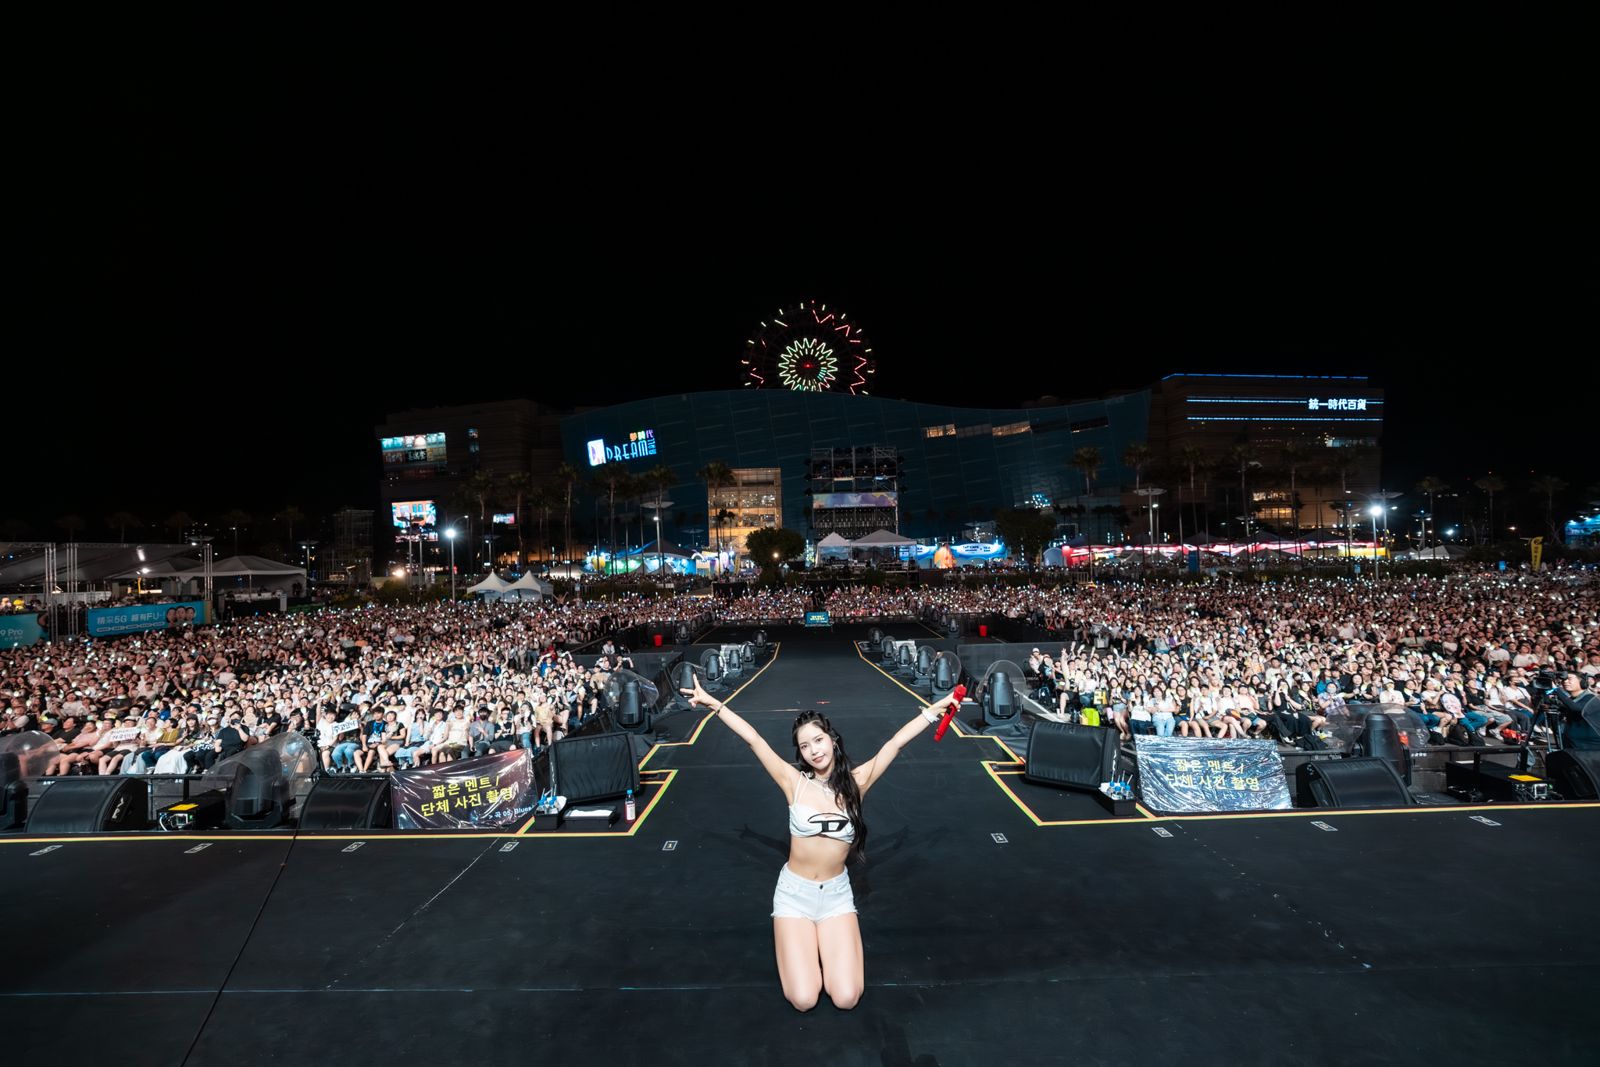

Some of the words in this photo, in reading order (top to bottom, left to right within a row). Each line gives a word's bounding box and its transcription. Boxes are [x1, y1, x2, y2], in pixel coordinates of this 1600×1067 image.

[1308, 398, 1367, 411] 統一時代百貨
[605, 439, 649, 462] DREAM
[431, 782, 461, 800] 짧은
[464, 776, 493, 792] 멘트
[421, 799, 450, 818] 단체
[454, 792, 482, 810] 사진
[486, 786, 513, 804] 촬영
